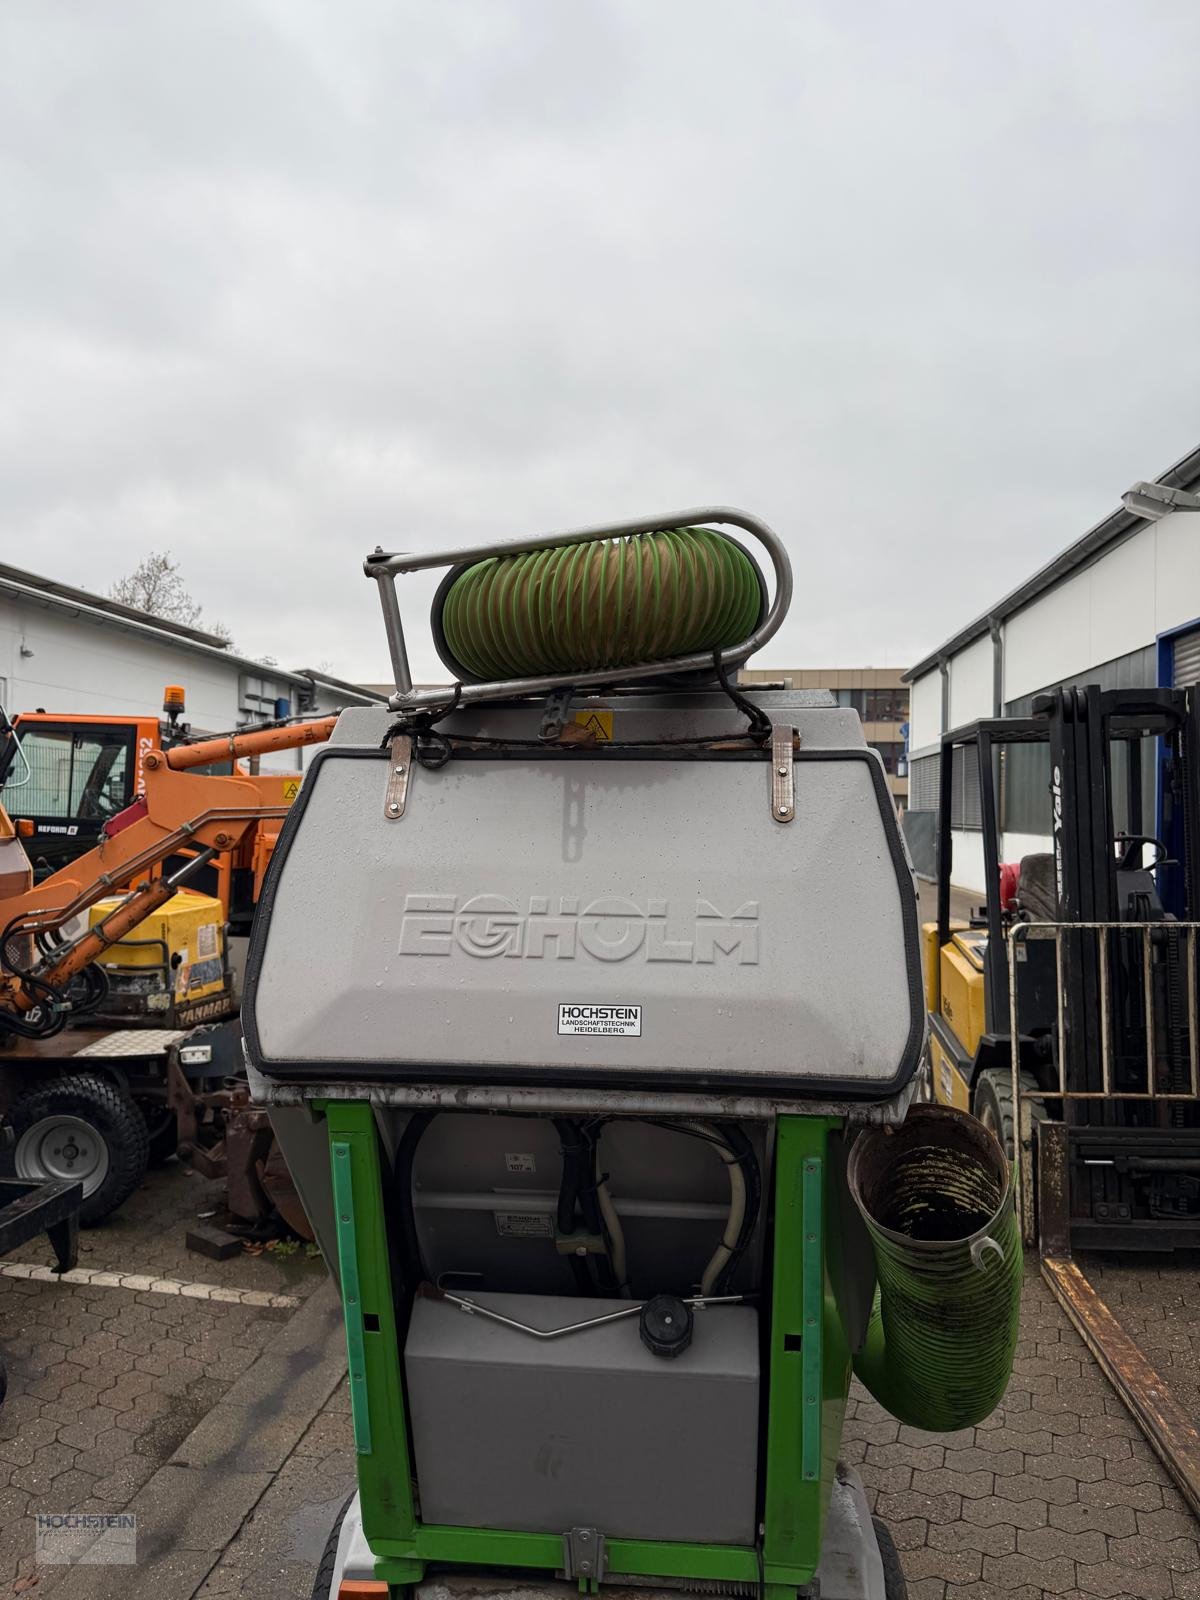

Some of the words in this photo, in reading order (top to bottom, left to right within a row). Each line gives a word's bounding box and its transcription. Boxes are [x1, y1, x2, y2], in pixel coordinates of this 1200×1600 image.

[37, 825, 67, 834] REFORM
[399, 894, 759, 965] EGHOLM
[178, 998, 231, 1024] YANMAR
[562, 1007, 638, 1019] HOCHSTEIN
